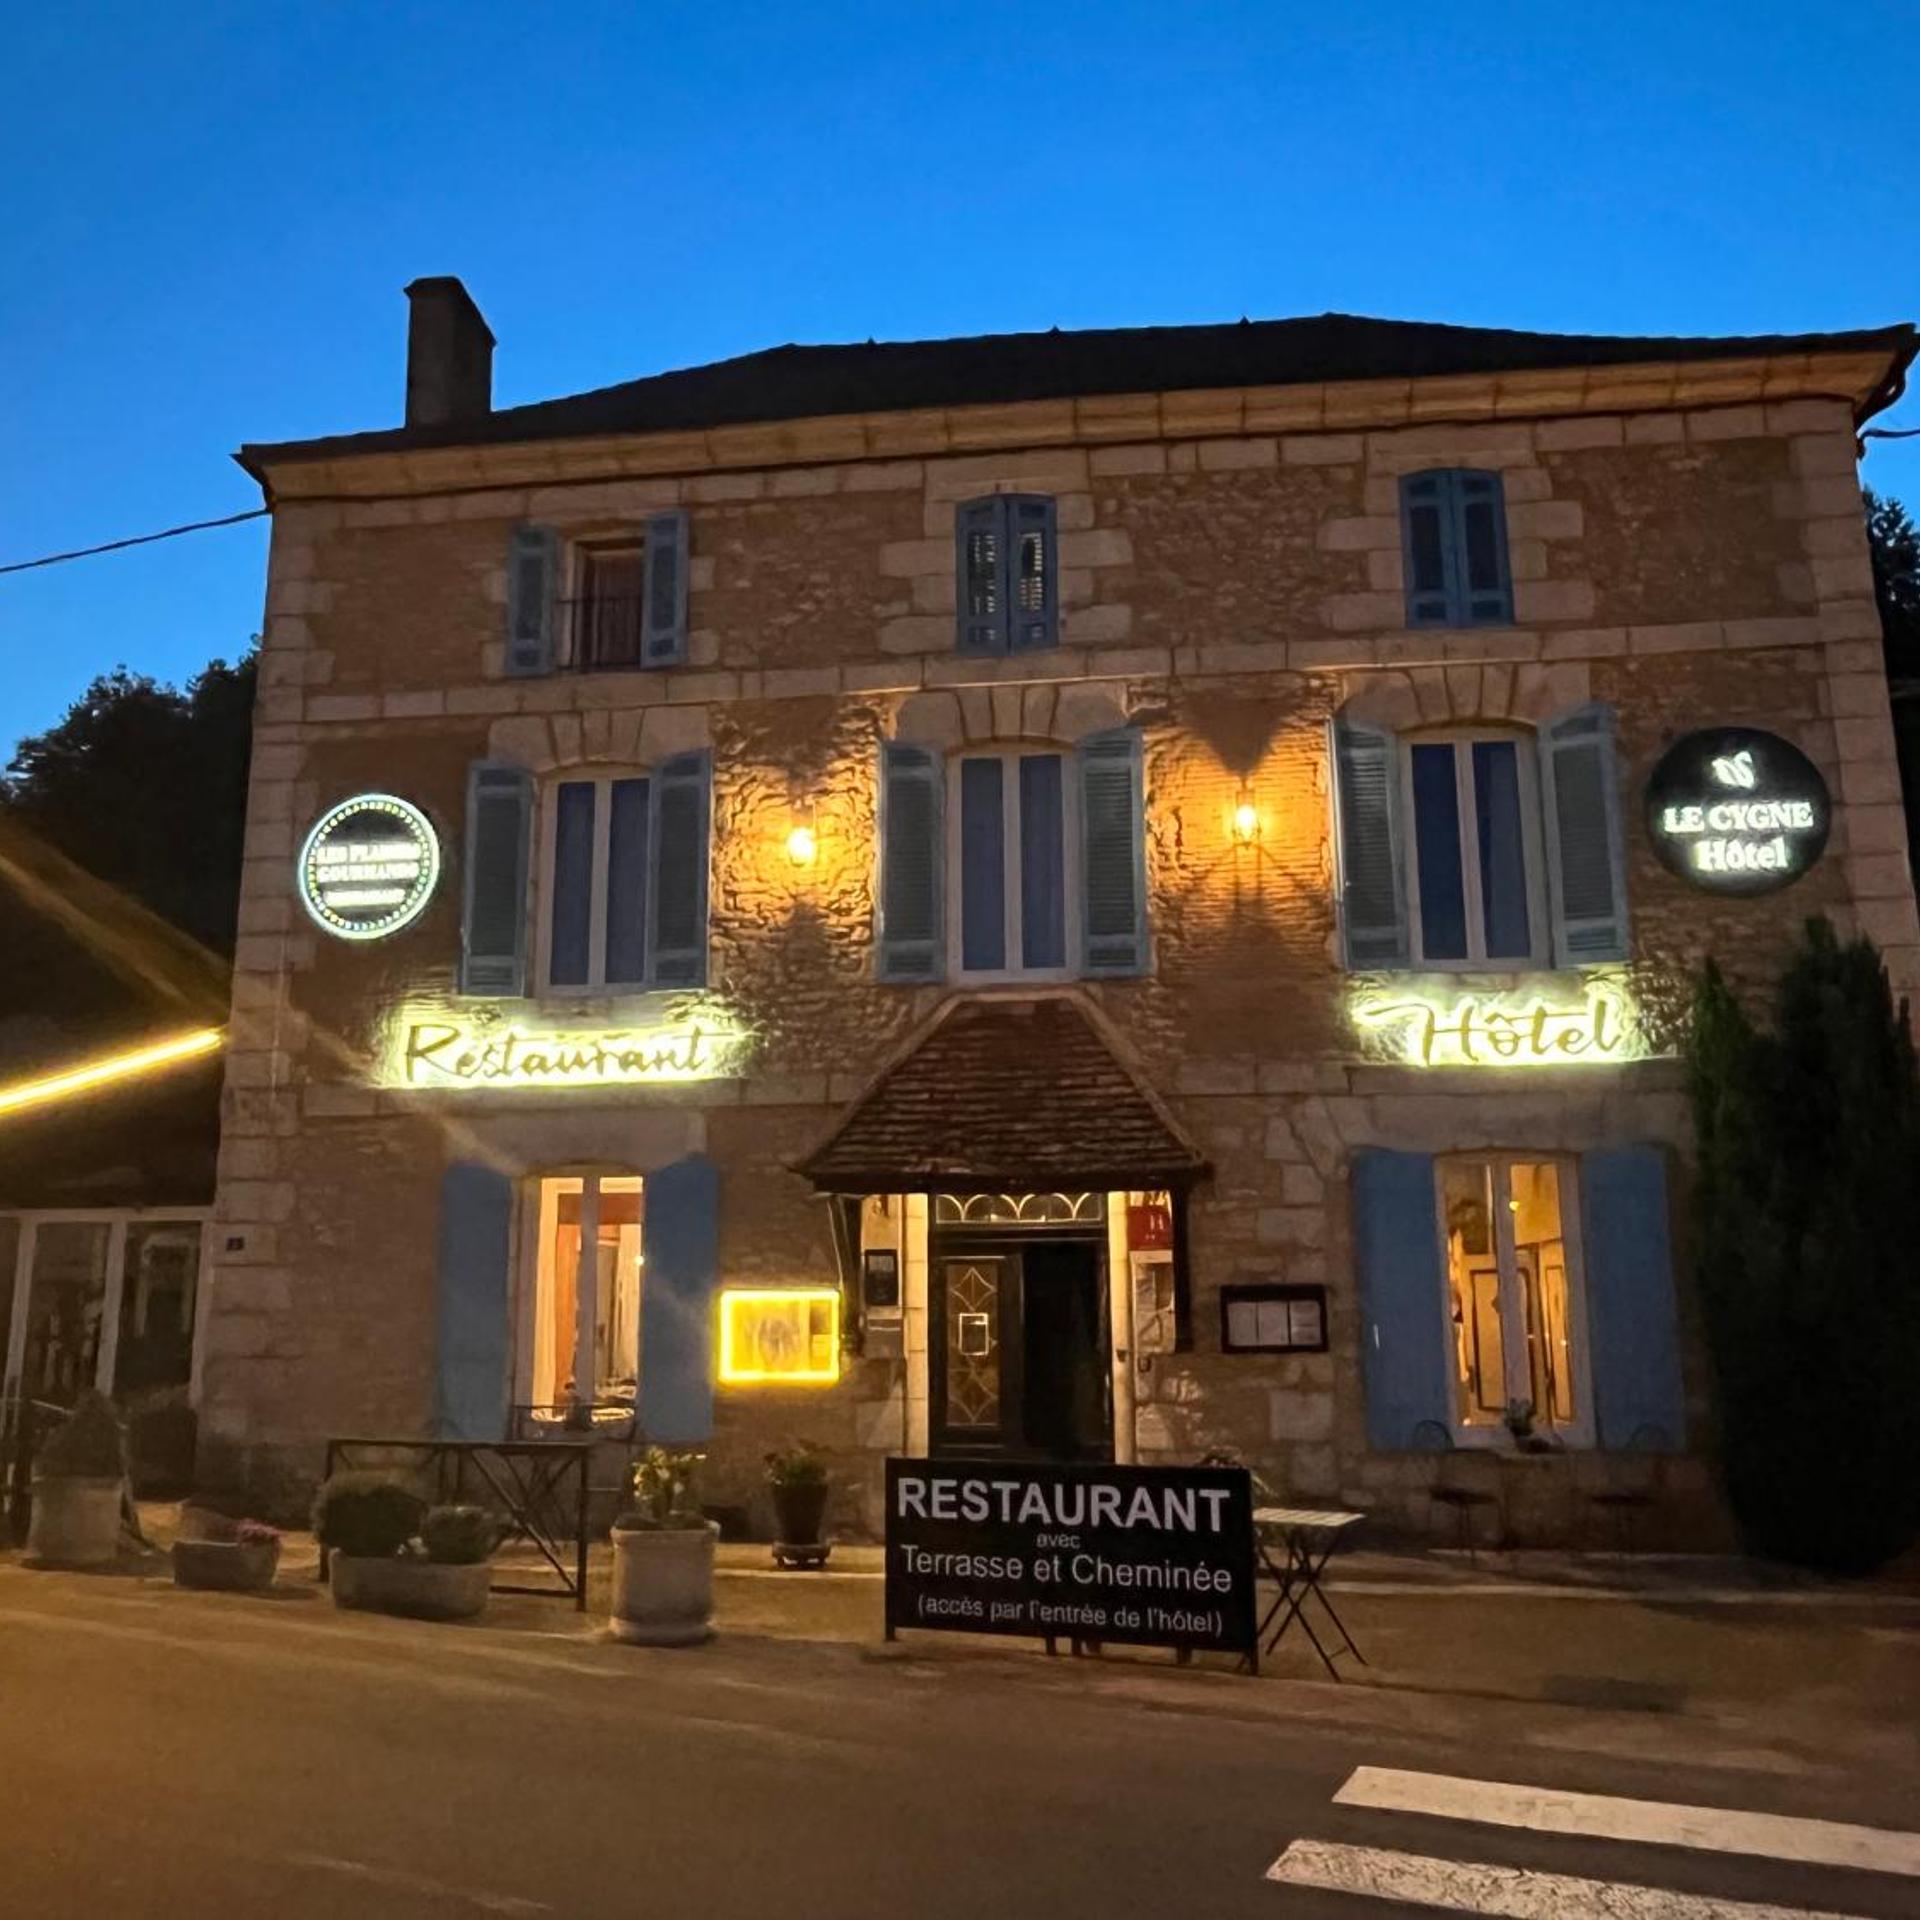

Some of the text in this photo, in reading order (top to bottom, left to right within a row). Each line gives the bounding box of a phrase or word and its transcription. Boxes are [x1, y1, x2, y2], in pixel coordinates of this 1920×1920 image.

[1663, 801, 1814, 833] LE CYGNE
[1695, 836, 1788, 872] Hôtel
[403, 1021, 757, 1083] Restaurant
[1364, 999, 1622, 1067] Hôtel
[897, 1476, 1231, 1533] RESTAURANT
[1036, 1532, 1081, 1550] avec
[901, 1544, 1233, 1593] Terrasse et Cheminée
[989, 1600, 1024, 1623] par
[1029, 1600, 1107, 1627] l'entrée
[1113, 1606, 1141, 1628] de
